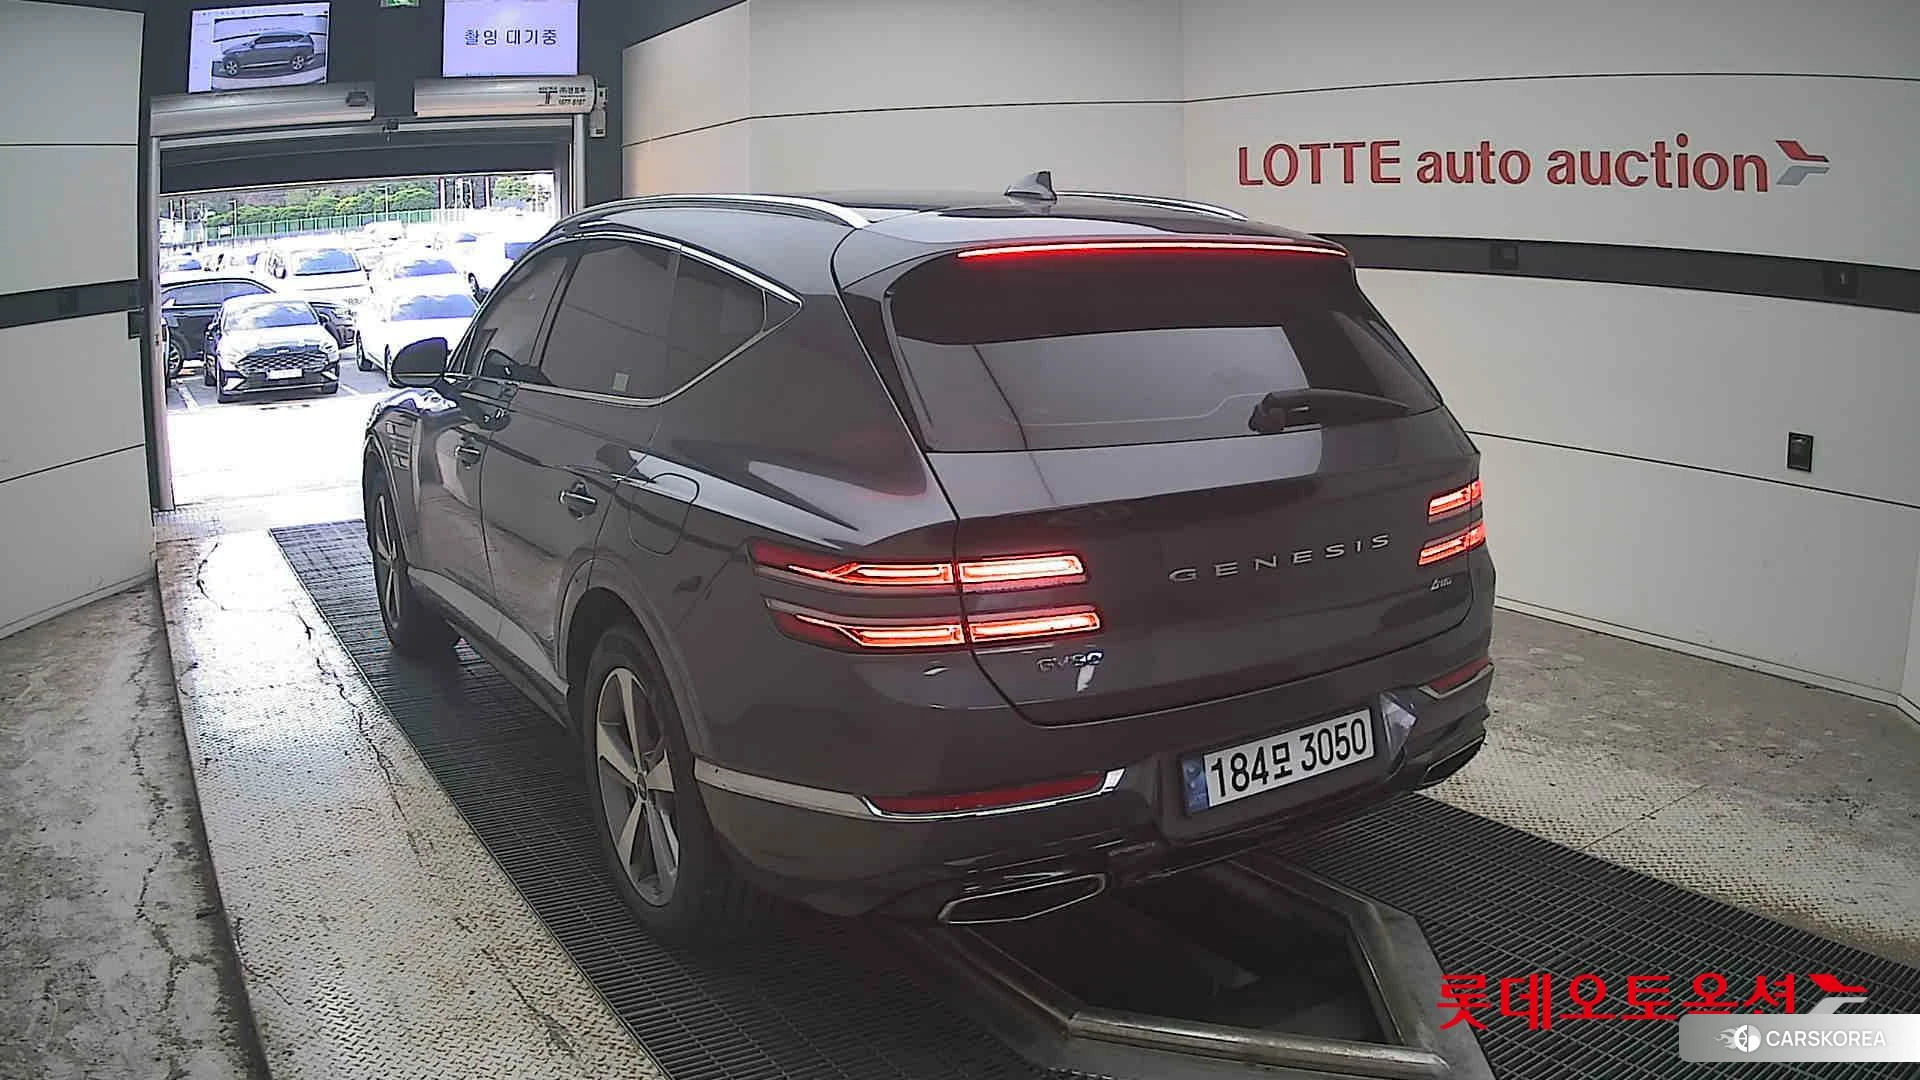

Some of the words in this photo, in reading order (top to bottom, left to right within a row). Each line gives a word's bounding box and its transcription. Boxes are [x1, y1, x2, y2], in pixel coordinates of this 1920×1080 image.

[506, 29, 557, 46] 대기중
[1239, 140, 1400, 187] LOTTE
[1417, 141, 1531, 185] auto
[1547, 133, 1769, 193] auction
[1168, 534, 1389, 582] GENESIS
[1211, 742, 1293, 798] 184모
[1299, 718, 1367, 772] 3050
